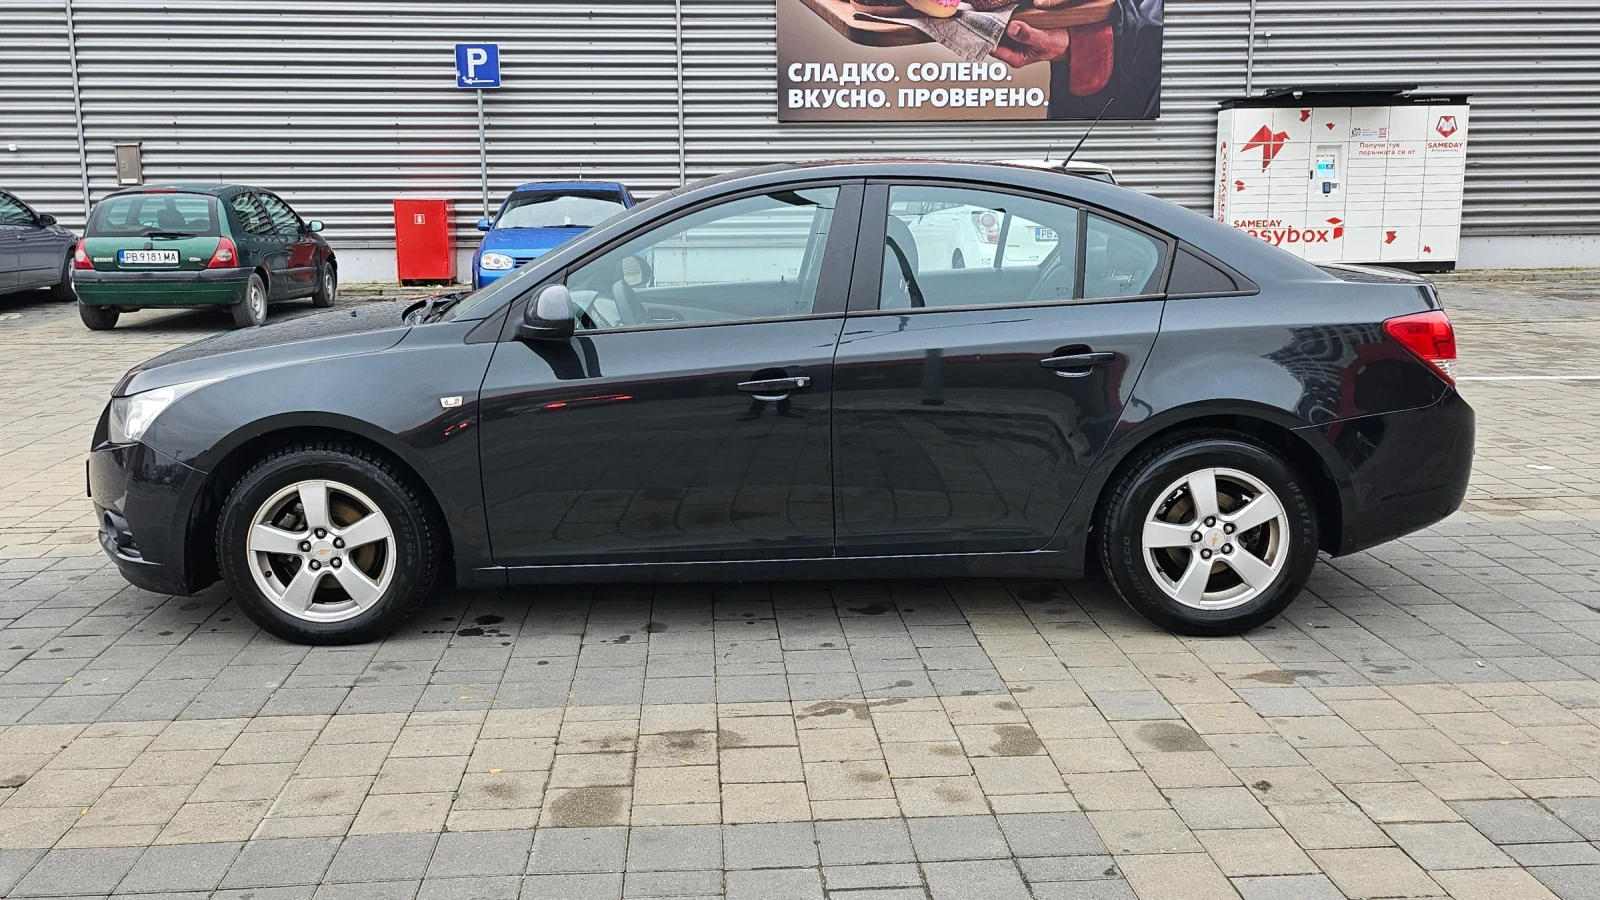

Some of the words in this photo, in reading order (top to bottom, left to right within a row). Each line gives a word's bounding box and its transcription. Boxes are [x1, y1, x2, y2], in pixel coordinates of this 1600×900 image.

[467, 48, 488, 78] P
[788, 63, 900, 86] СЛАДКО.
[907, 62, 1013, 82] СОЛЕНО.
[788, 88, 891, 108] ВКУСНО.
[898, 88, 1050, 108] ПРОВЕРЕНО.
[1234, 220, 1282, 228] SAMEDAY
